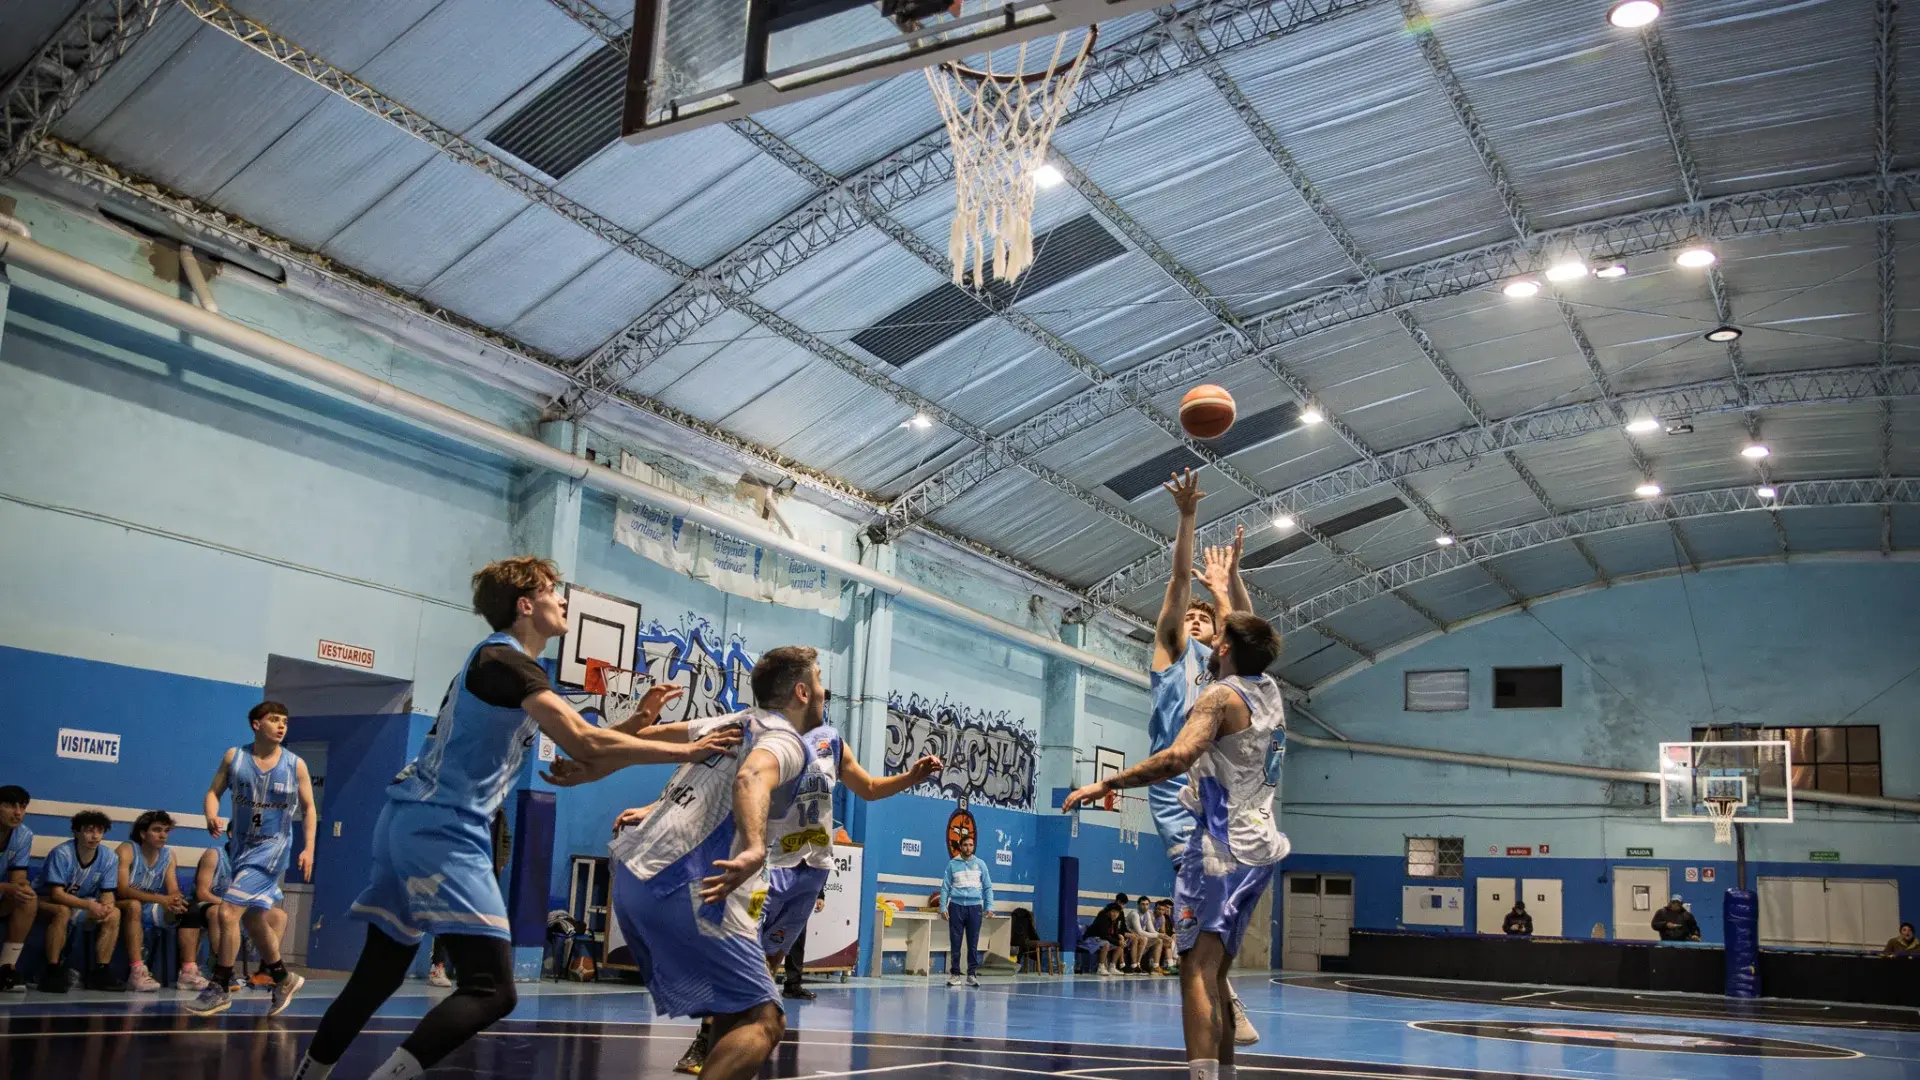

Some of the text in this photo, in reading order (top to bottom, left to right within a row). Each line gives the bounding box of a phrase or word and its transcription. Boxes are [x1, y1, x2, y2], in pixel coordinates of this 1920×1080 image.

[321, 643, 372, 665] VESTUARIOS
[61, 735, 117, 756] VISITANTE
[797, 799, 820, 828] 14
[903, 842, 920, 853] PRENSA
[997, 852, 1012, 863] PRENSA
